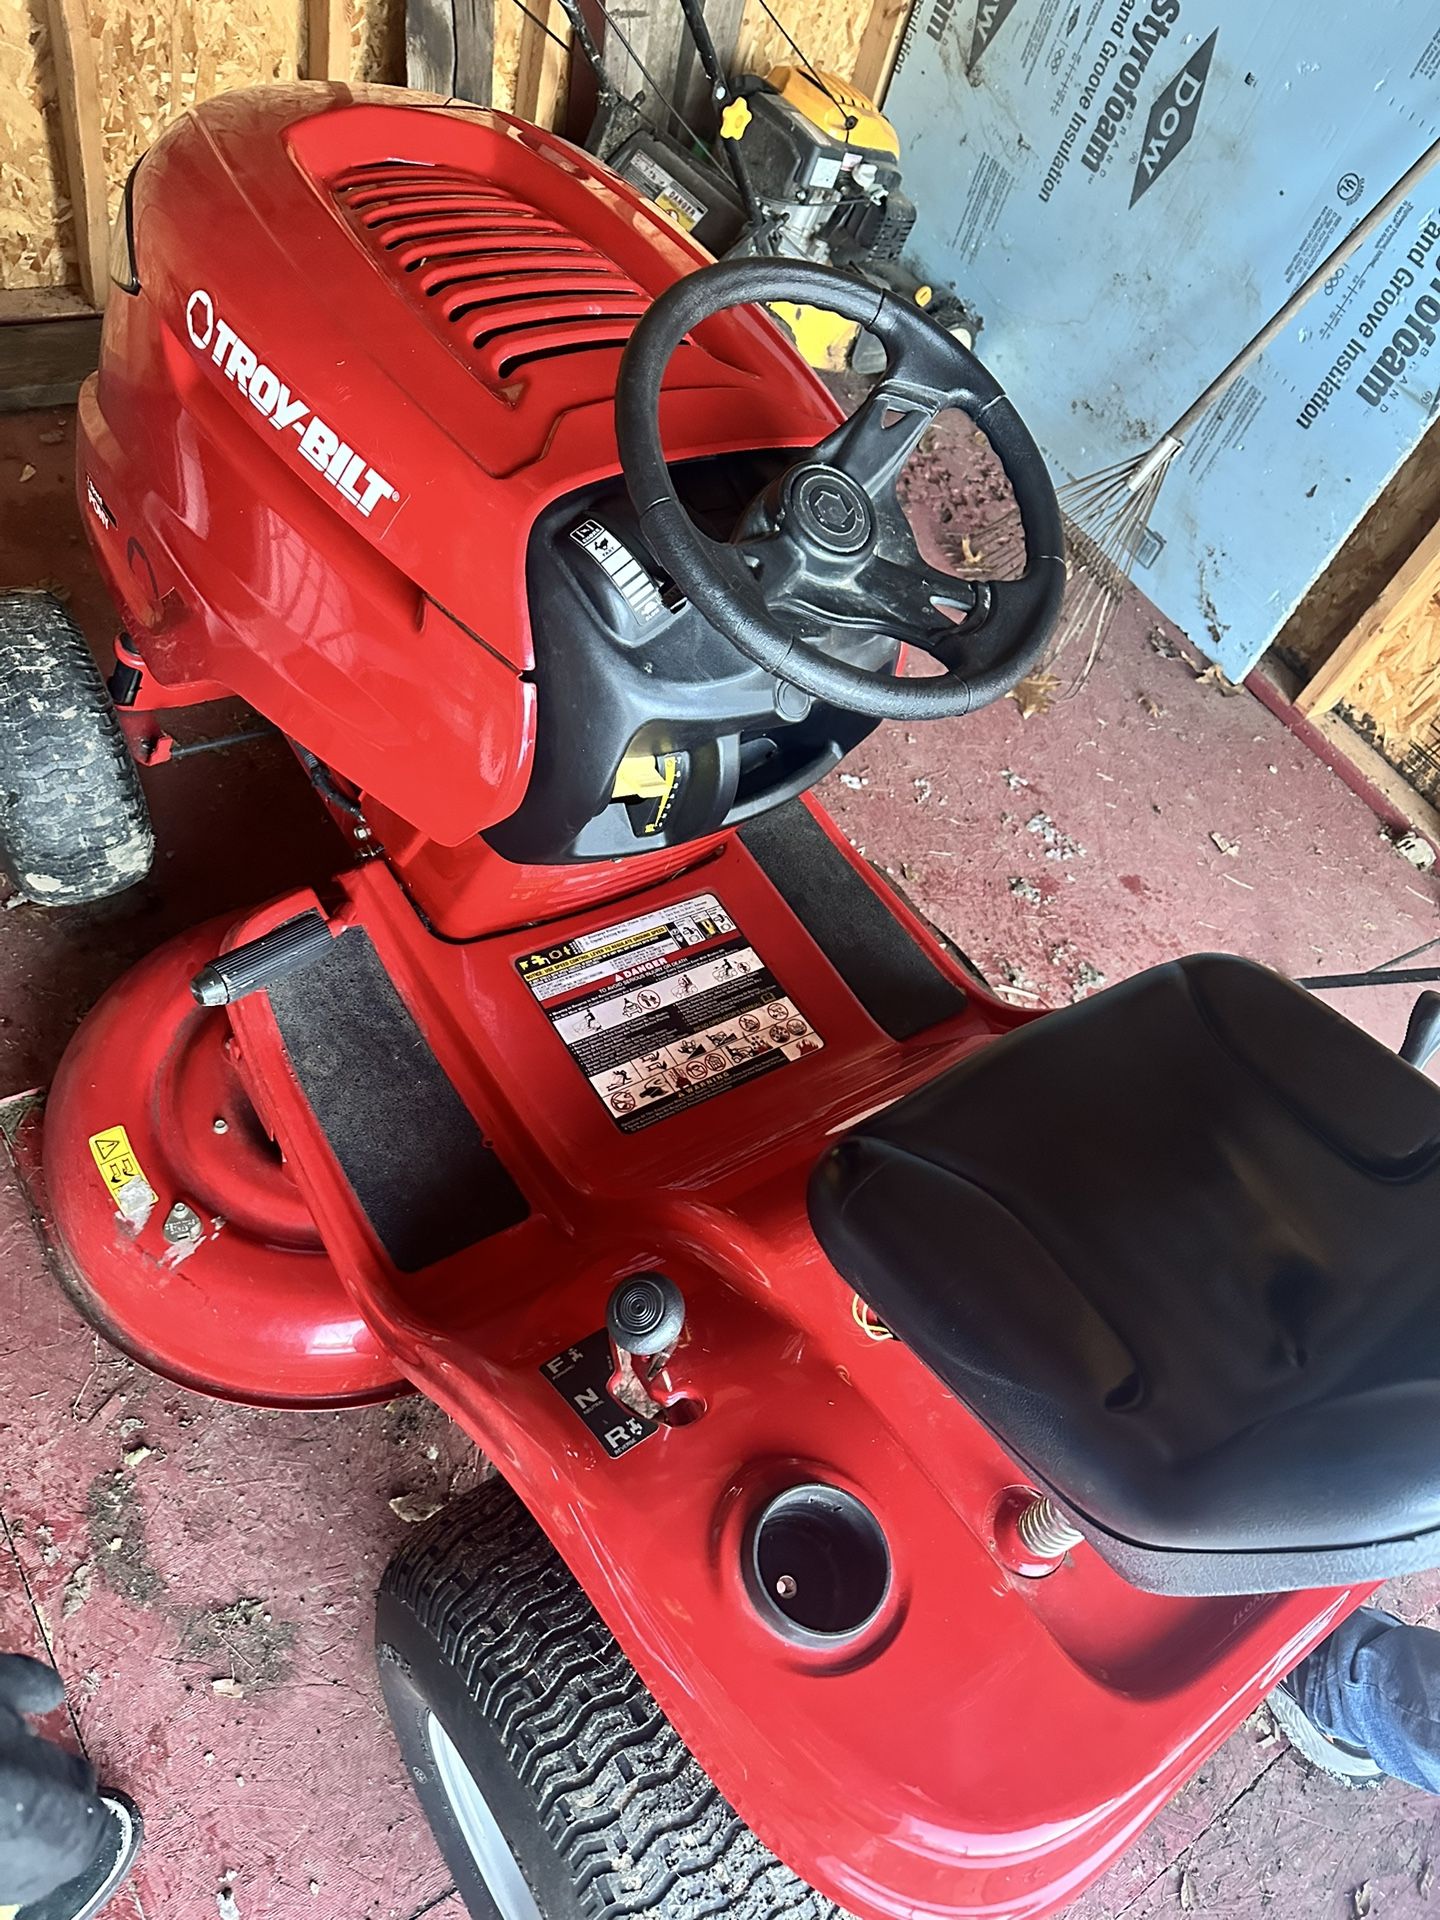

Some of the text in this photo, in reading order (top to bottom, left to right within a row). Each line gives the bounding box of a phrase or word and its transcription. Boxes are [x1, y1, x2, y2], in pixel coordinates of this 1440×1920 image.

[1079, 40, 1118, 111] Groove
[1081, 0, 1181, 173] Styrofoam
[1141, 71, 1204, 178] DOW
[1038, 111, 1087, 203] Insulation
[1407, 221, 1440, 269] and
[1359, 267, 1414, 338] Groove
[1296, 338, 1367, 429] Insulation
[211, 318, 395, 518] TROY-BILT
[554, 961, 570, 971] SPEED
[569, 954, 590, 965] CONTROL
[590, 949, 605, 958] LEVER
[650, 928, 666, 936] SPEED
[606, 982, 623, 992] AVOID
[622, 974, 645, 986] SERIOUS
[644, 967, 664, 977] INJURY
[670, 958, 689, 968] DEATH
[622, 957, 669, 979] DANGER
[574, 1387, 599, 1409] N
[604, 1425, 630, 1449] R
[614, 1438, 637, 1455] REVERSE
